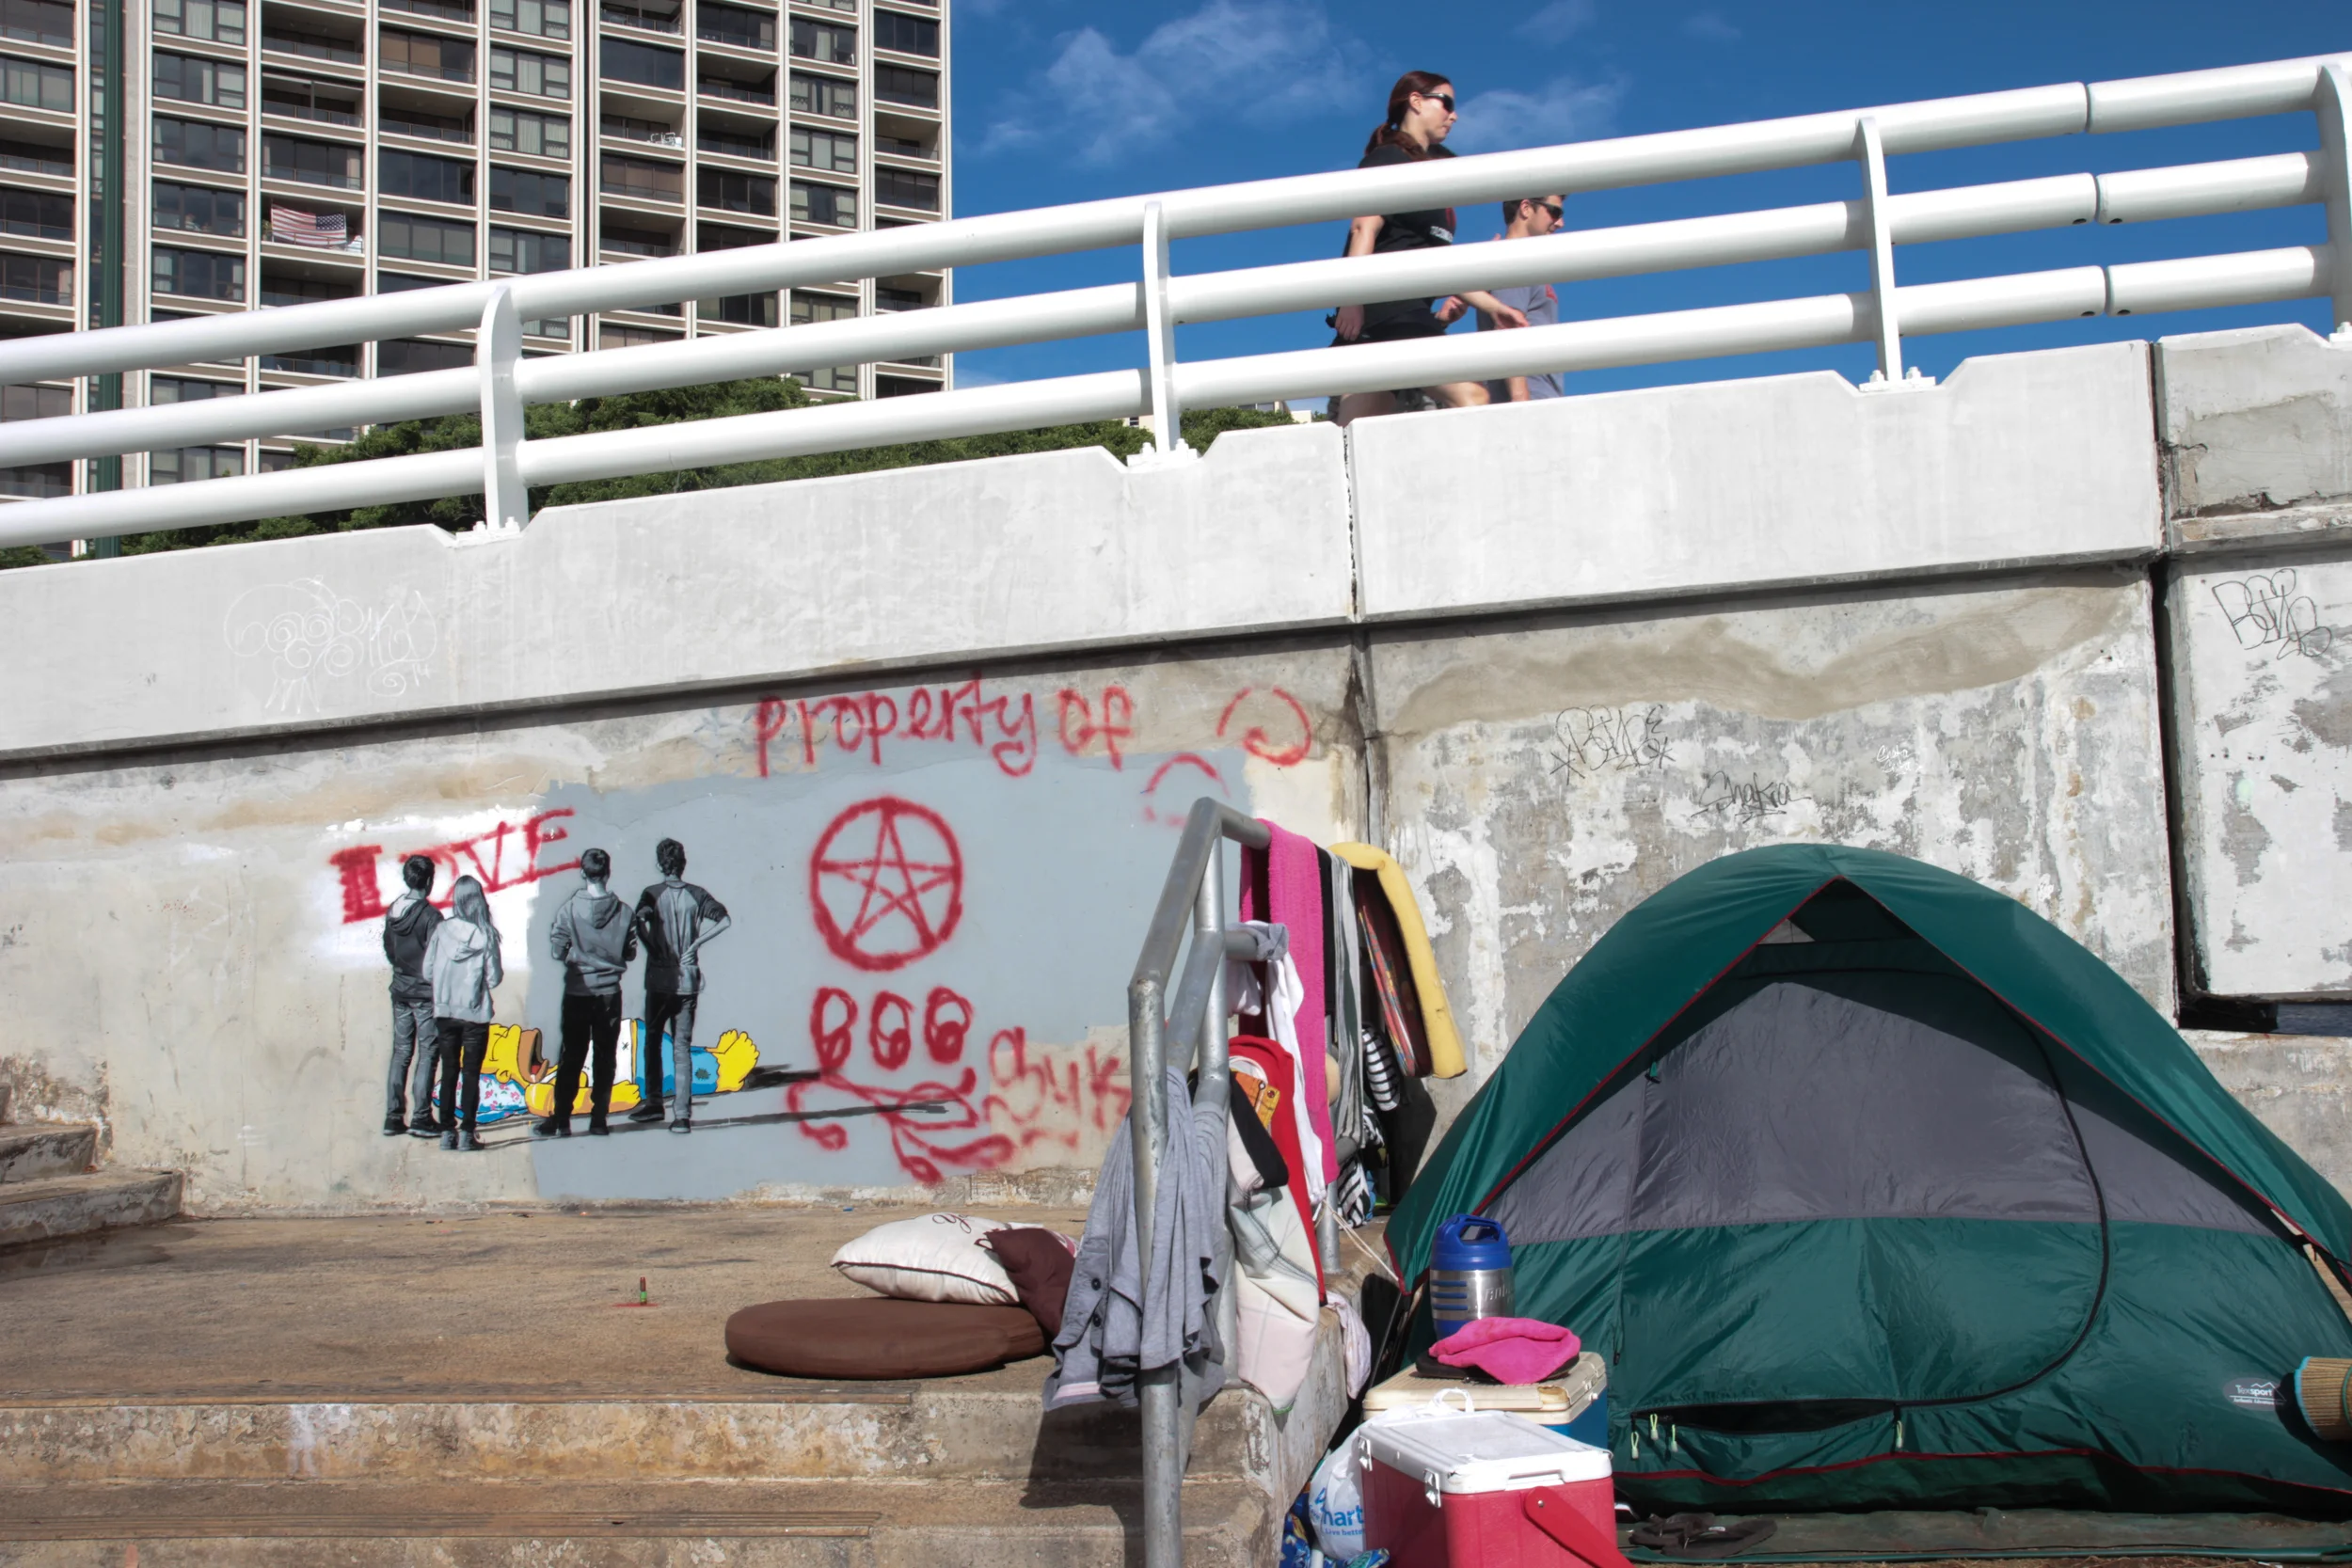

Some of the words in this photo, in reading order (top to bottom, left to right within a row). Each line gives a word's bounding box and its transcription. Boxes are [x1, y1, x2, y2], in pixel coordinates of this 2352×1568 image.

[753, 670, 1036, 778] property
[1057, 685, 1136, 773] of
[1342, 1528, 1365, 1536] bette
